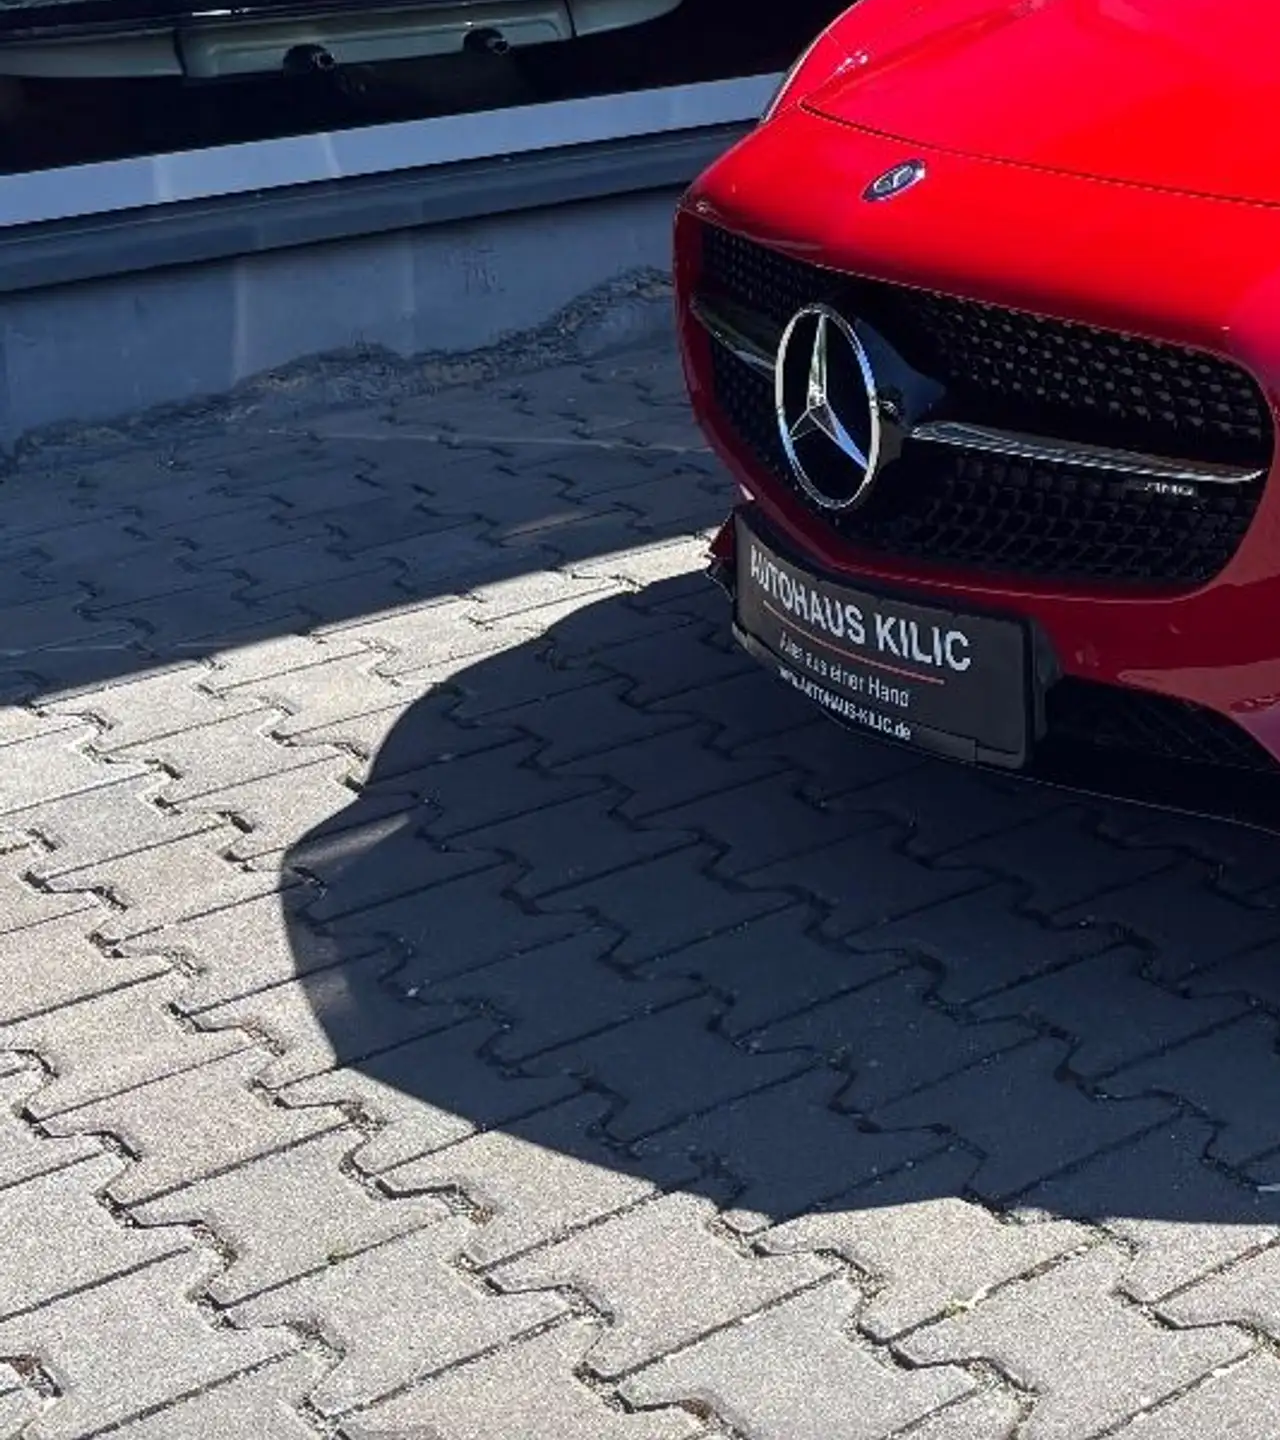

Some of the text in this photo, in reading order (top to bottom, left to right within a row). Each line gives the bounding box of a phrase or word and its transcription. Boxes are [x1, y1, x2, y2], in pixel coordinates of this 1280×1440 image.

[750, 544, 972, 672] AUTOHAUS KILIC
[830, 663, 864, 692] einer
[868, 675, 910, 708] Hand
